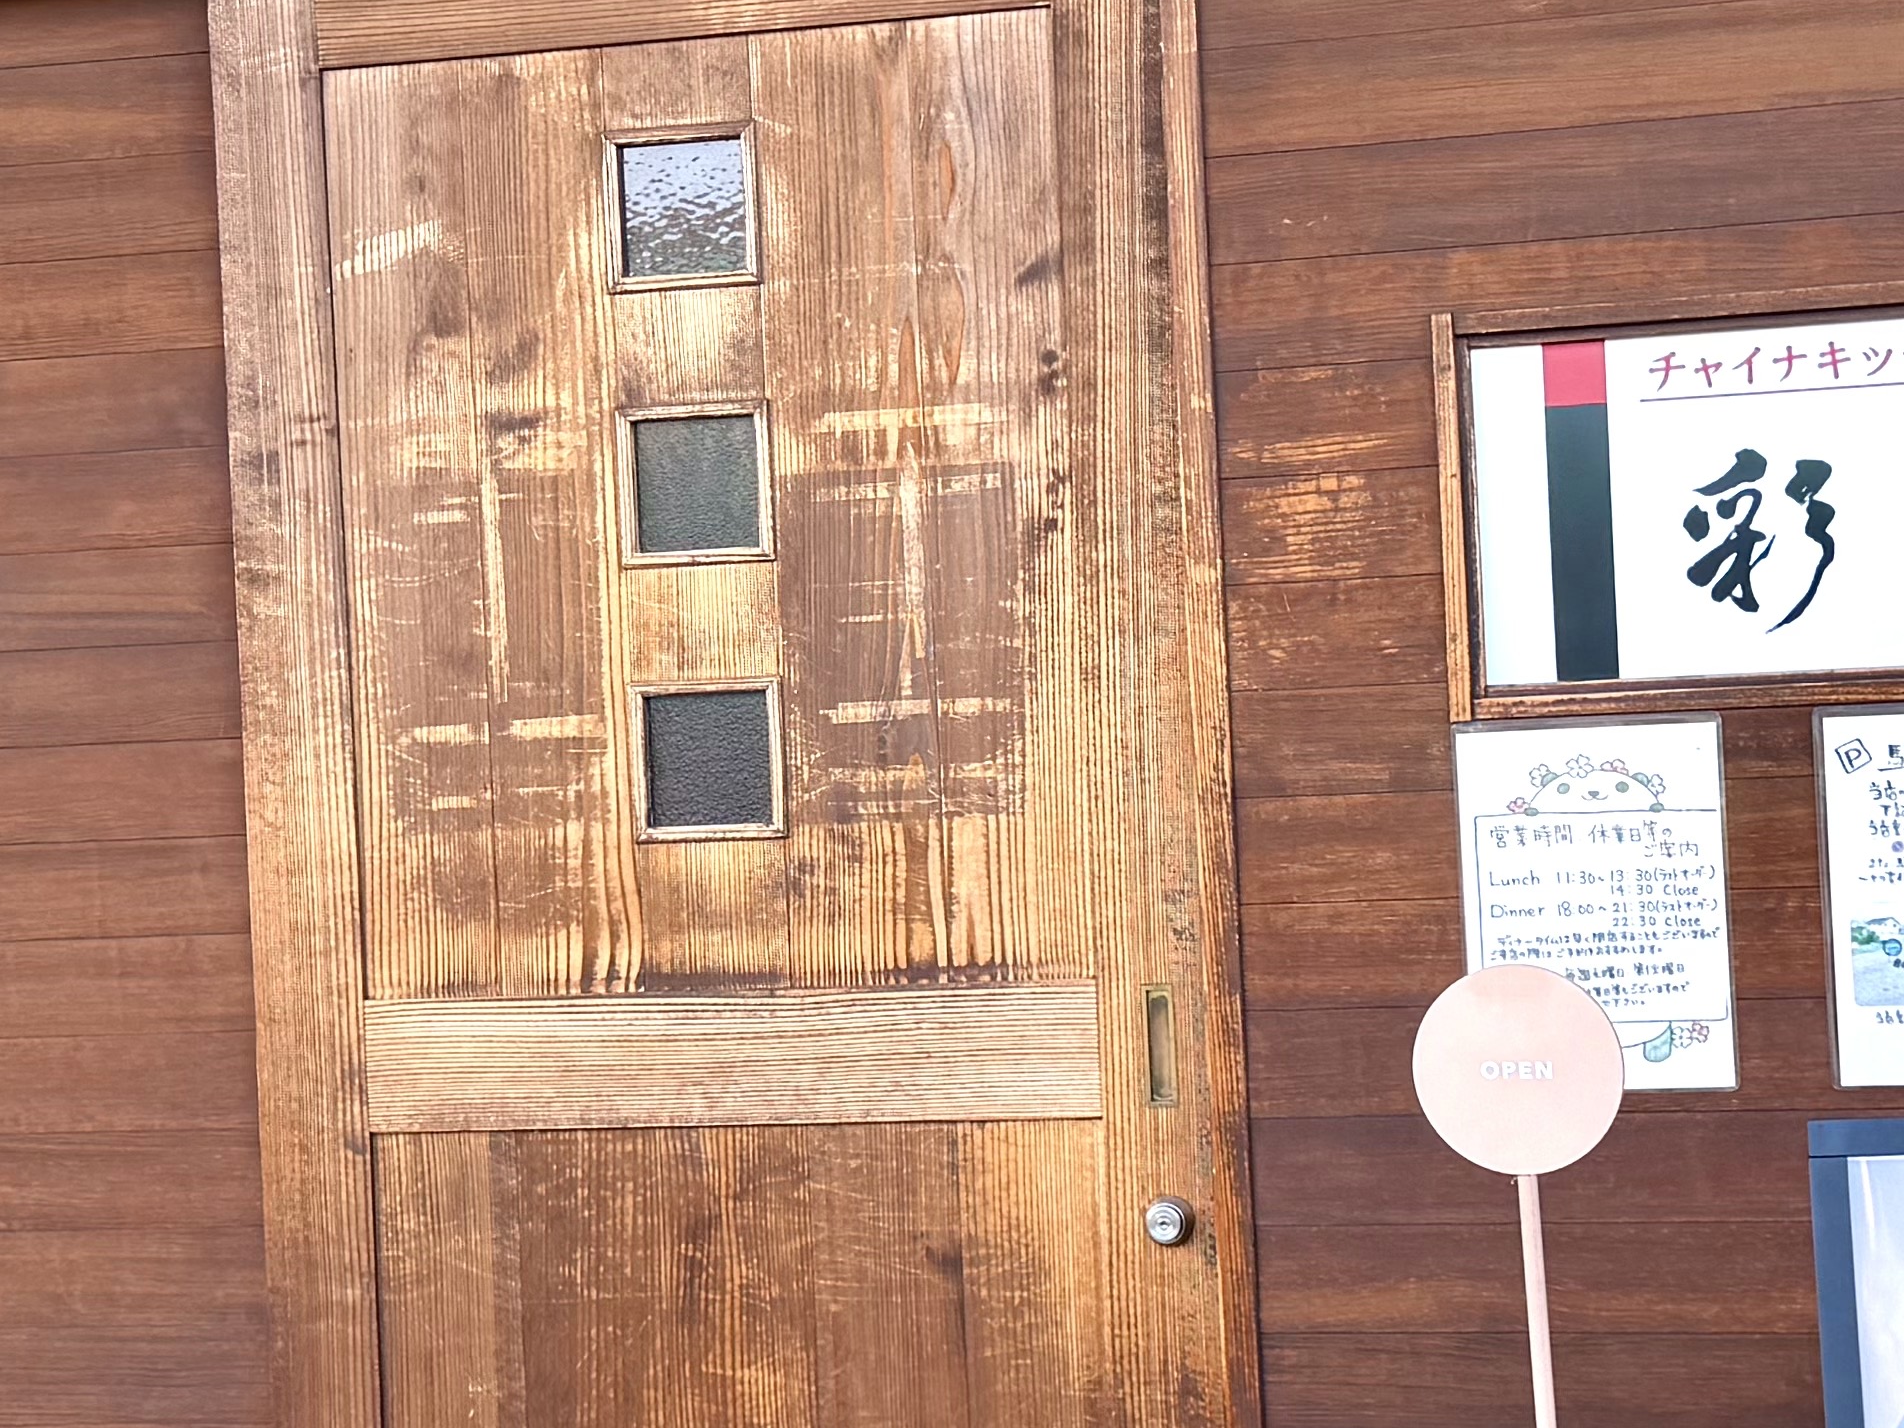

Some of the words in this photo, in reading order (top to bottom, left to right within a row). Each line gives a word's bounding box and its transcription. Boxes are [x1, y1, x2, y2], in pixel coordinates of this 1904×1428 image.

[1844, 748, 1862, 769] P
[1489, 824, 1572, 847] 営業時間
[1644, 841, 1699, 858] ご案内
[1489, 870, 1540, 887] Lunch
[1663, 882, 1699, 896] Close
[1490, 902, 1545, 919] Dinner
[1665, 914, 1701, 928] Close
[1480, 1060, 1554, 1081] OPEN
